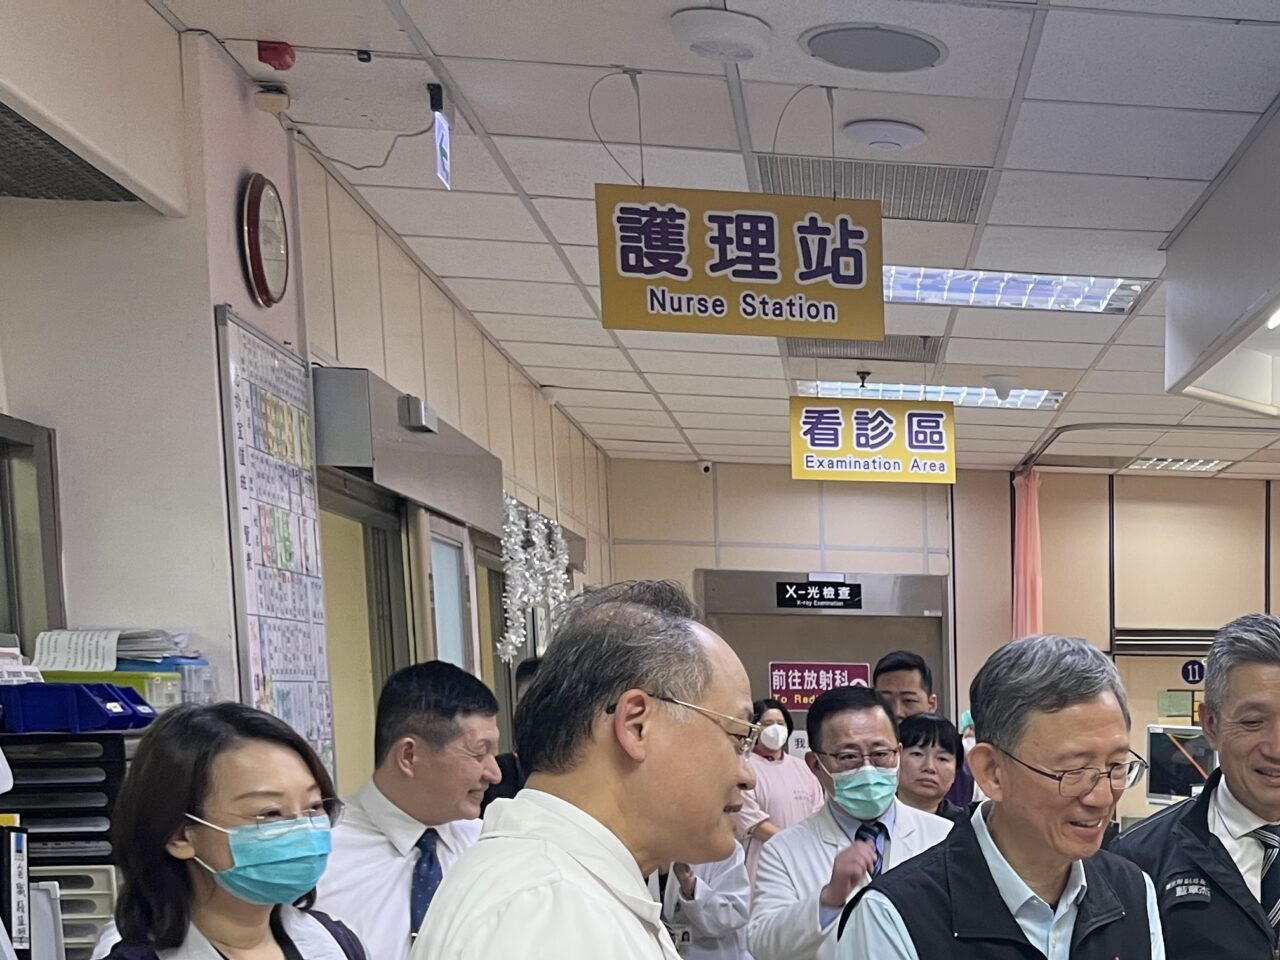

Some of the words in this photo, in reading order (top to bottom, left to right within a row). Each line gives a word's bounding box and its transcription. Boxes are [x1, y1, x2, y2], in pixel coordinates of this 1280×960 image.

[616, 206, 865, 285] 護理站
[648, 289, 725, 315] Nurse
[741, 293, 836, 320] Station
[802, 409, 945, 450] 看診區
[805, 455, 901, 471] Examination
[911, 458, 946, 472] Area
[772, 669, 848, 691] 前往放射科
[1187, 664, 1200, 681] 11
[772, 694, 788, 704] To
[794, 694, 818, 704] Rad
